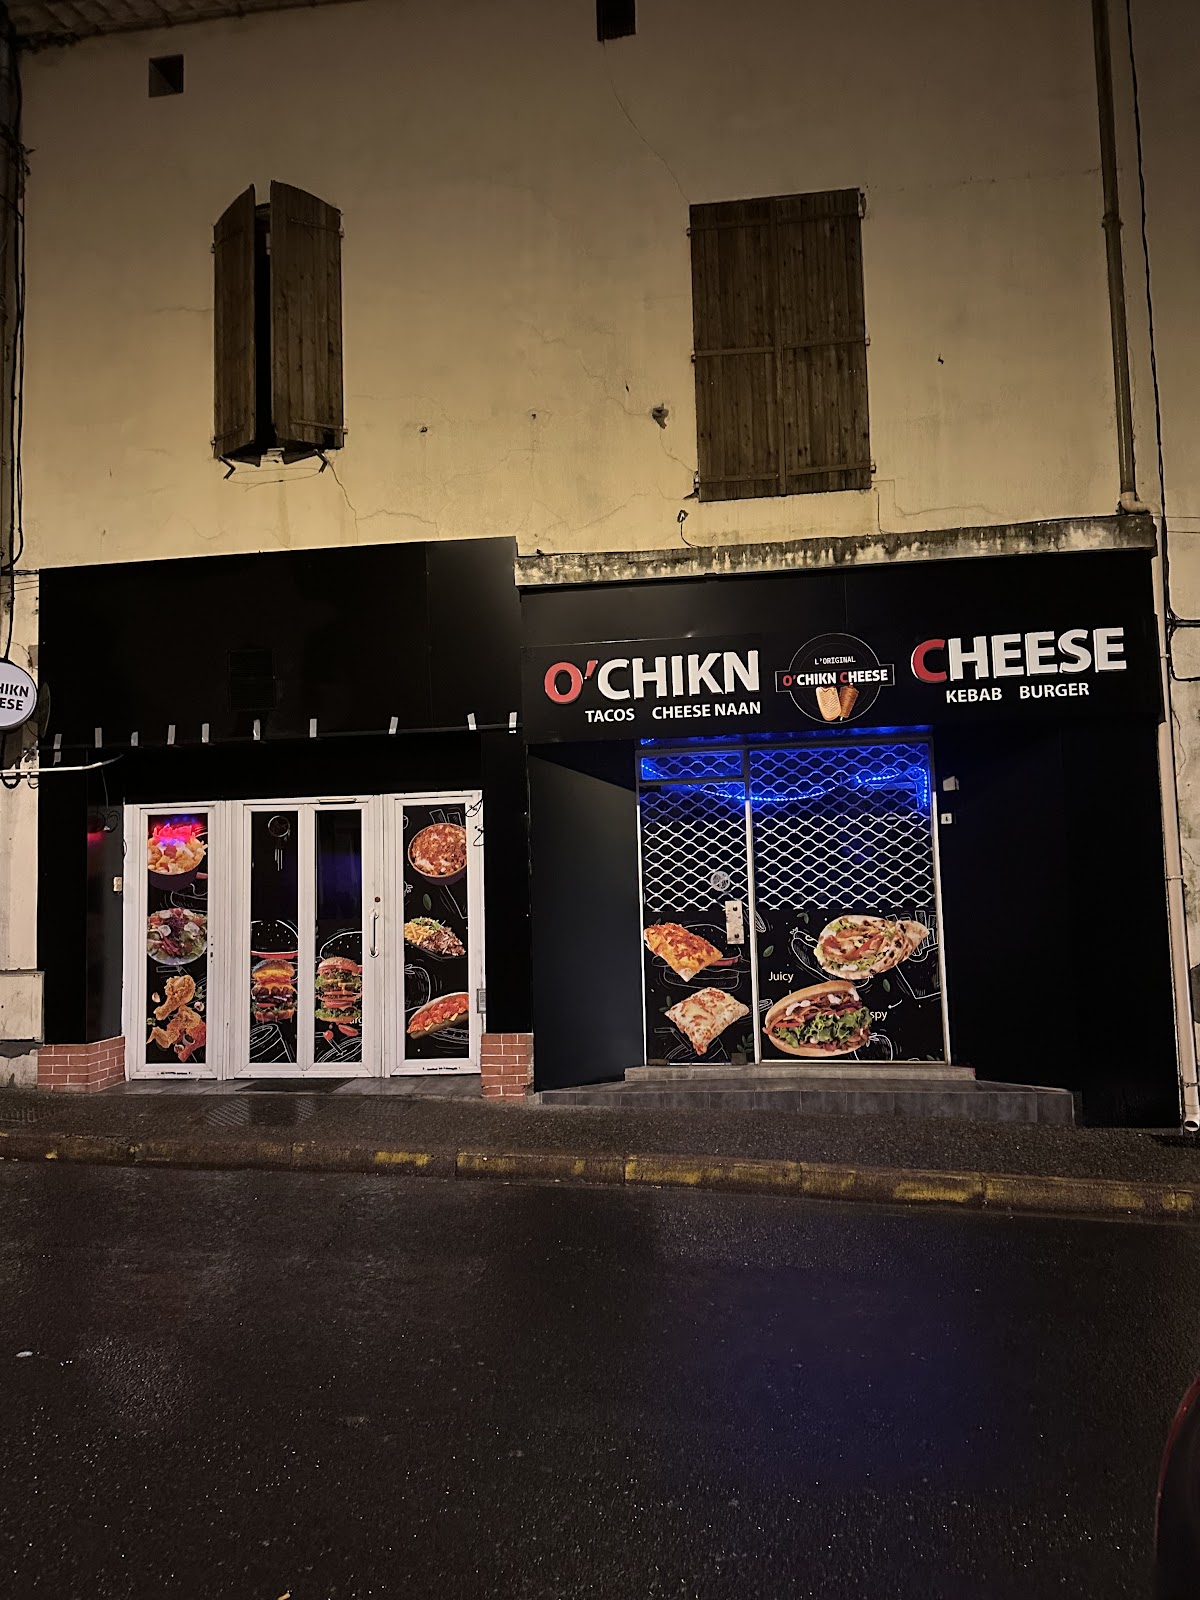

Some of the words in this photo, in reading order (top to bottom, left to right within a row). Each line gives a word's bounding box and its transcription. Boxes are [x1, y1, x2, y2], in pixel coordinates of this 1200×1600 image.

[814, 656, 856, 666] L'ORIGINAL
[911, 627, 1127, 683] CHEESE
[544, 650, 760, 704] O'CHIKN
[782, 672, 837, 687] O'CHIKN
[839, 669, 889, 684] CHEESE
[946, 687, 1003, 703] KEBAB
[1019, 683, 1090, 699] BURGER
[585, 708, 635, 723] TACOS
[652, 704, 711, 720] CHEESE
[714, 701, 761, 716] NAAN
[768, 971, 794, 983] Juicy
